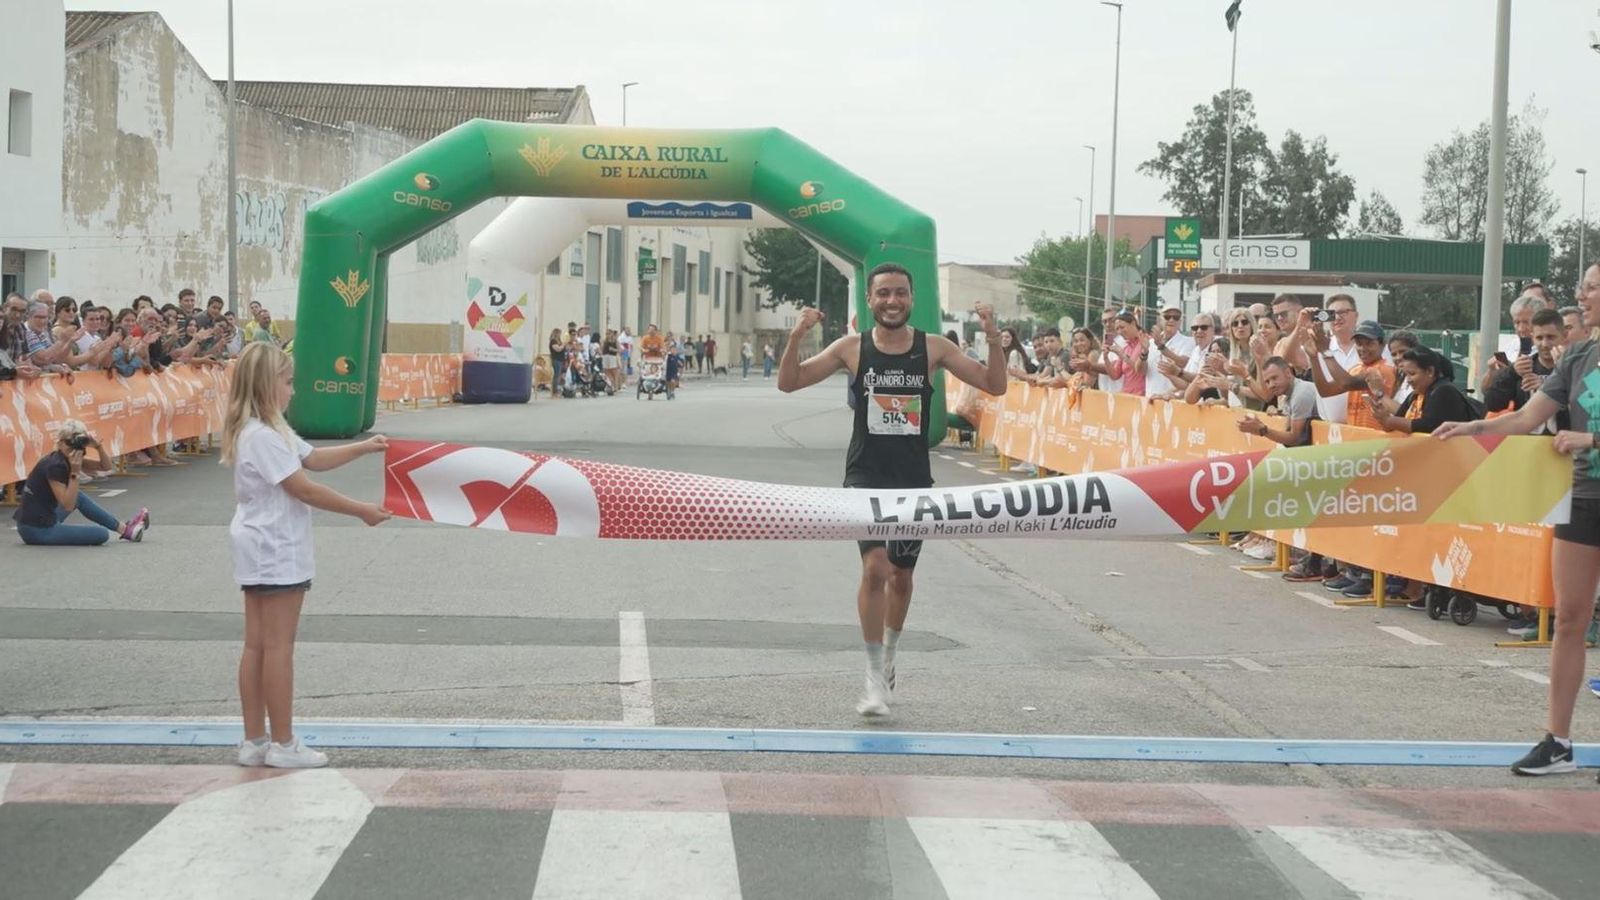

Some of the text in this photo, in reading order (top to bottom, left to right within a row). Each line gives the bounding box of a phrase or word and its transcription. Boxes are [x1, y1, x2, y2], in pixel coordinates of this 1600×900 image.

[582, 144, 728, 163] CAIXA RURAL
[601, 165, 708, 180] DE L'ALCÚDIA
[393, 191, 452, 212] canso
[788, 198, 845, 219] canso
[1213, 244, 1298, 258] canso
[863, 374, 925, 388] ALEJANDRO SANZ
[882, 411, 909, 424] 5143
[1265, 449, 1394, 487] Diputació
[869, 476, 1112, 523] L'ALCUDIA
[1264, 486, 1418, 519] de València
[867, 514, 1118, 537] VIII Mitja Marató del Kaki L'Alcudia
